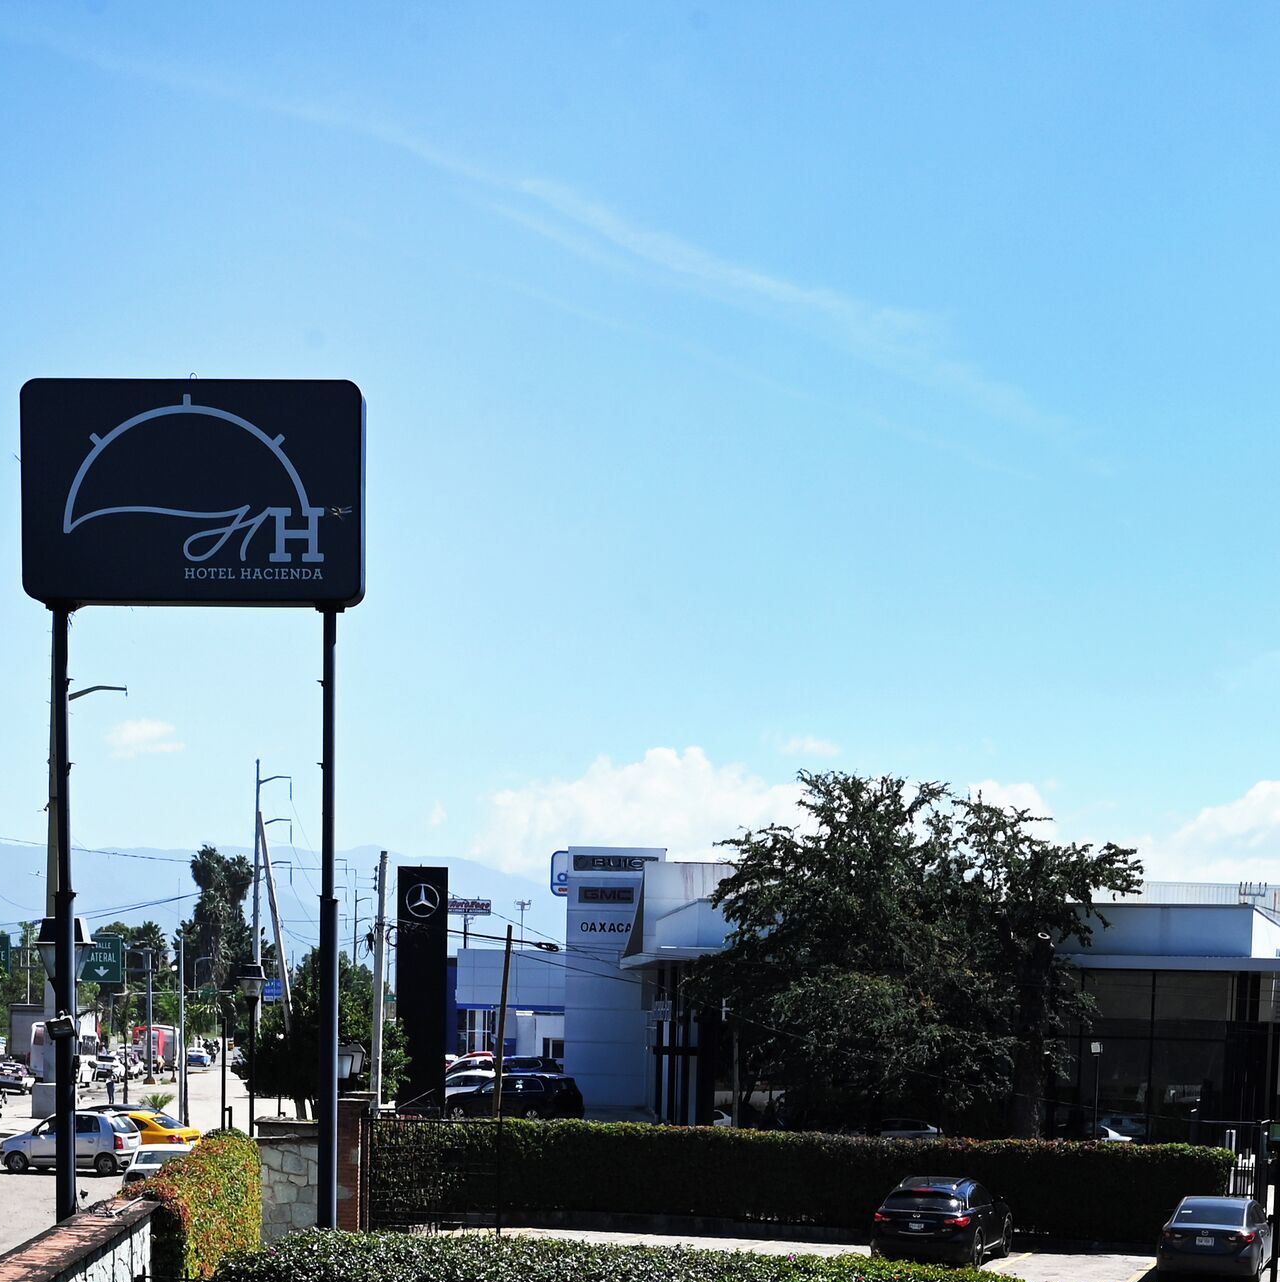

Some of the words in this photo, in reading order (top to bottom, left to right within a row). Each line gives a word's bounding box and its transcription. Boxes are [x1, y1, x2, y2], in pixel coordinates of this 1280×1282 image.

[184, 567, 236, 580] HOTEL
[240, 567, 324, 580] HACIENDA
[583, 888, 632, 902] GMC
